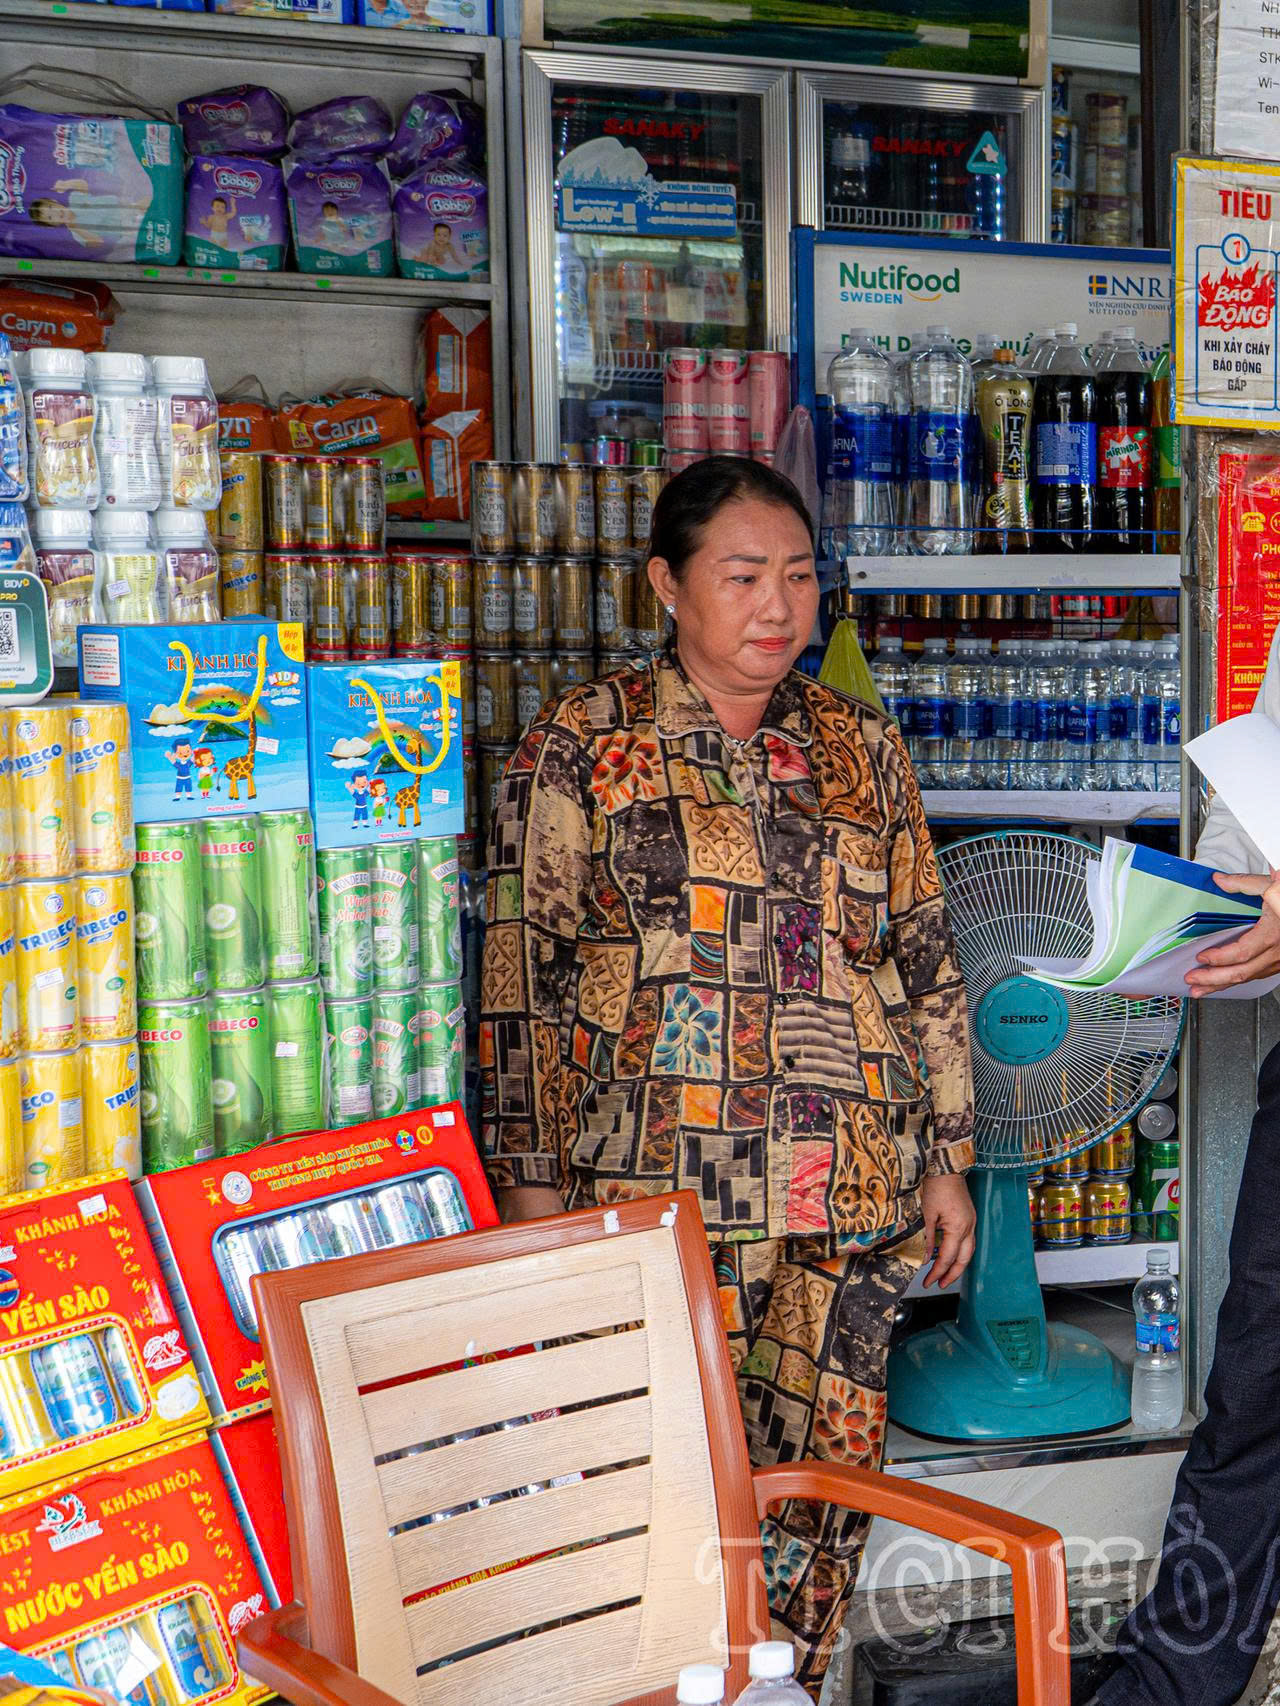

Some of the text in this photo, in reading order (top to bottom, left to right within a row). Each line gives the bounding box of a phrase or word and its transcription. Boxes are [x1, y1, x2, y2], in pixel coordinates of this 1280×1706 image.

[1261, 2, 1280, 14] NH
[1258, 102, 1280, 116] Ten
[431, 197, 473, 213] Bobby
[1219, 185, 1272, 221] TIÊU
[1232, 240, 1242, 259] 1
[839, 262, 961, 294] Nutifood
[840, 291, 903, 305] SWEDEN
[1214, 284, 1254, 303] BÁO
[1088, 308, 1138, 316] NUTIFOOD
[1205, 303, 1268, 329] ĐỘNG
[0, 312, 58, 337] Caryn
[1204, 337, 1270, 356] KHI XẢY CHÁY
[1213, 357, 1262, 376] BÁO ĐỘNG
[1228, 376, 1247, 392] GẤP
[1004, 399, 1032, 408] LONG
[312, 414, 378, 441] Caryn
[4, 578, 23, 589] BIDV
[268, 672, 300, 686] KIDS
[999, 1013, 1049, 1025] SENKO
[15, 1213, 80, 1244] KHÁNH
[1, 1285, 111, 1336] YẾN SÀO
[100, 1467, 203, 1517] KHÁNH HÒA
[5, 1540, 191, 1635] NƯỚC YẾN SÀO
